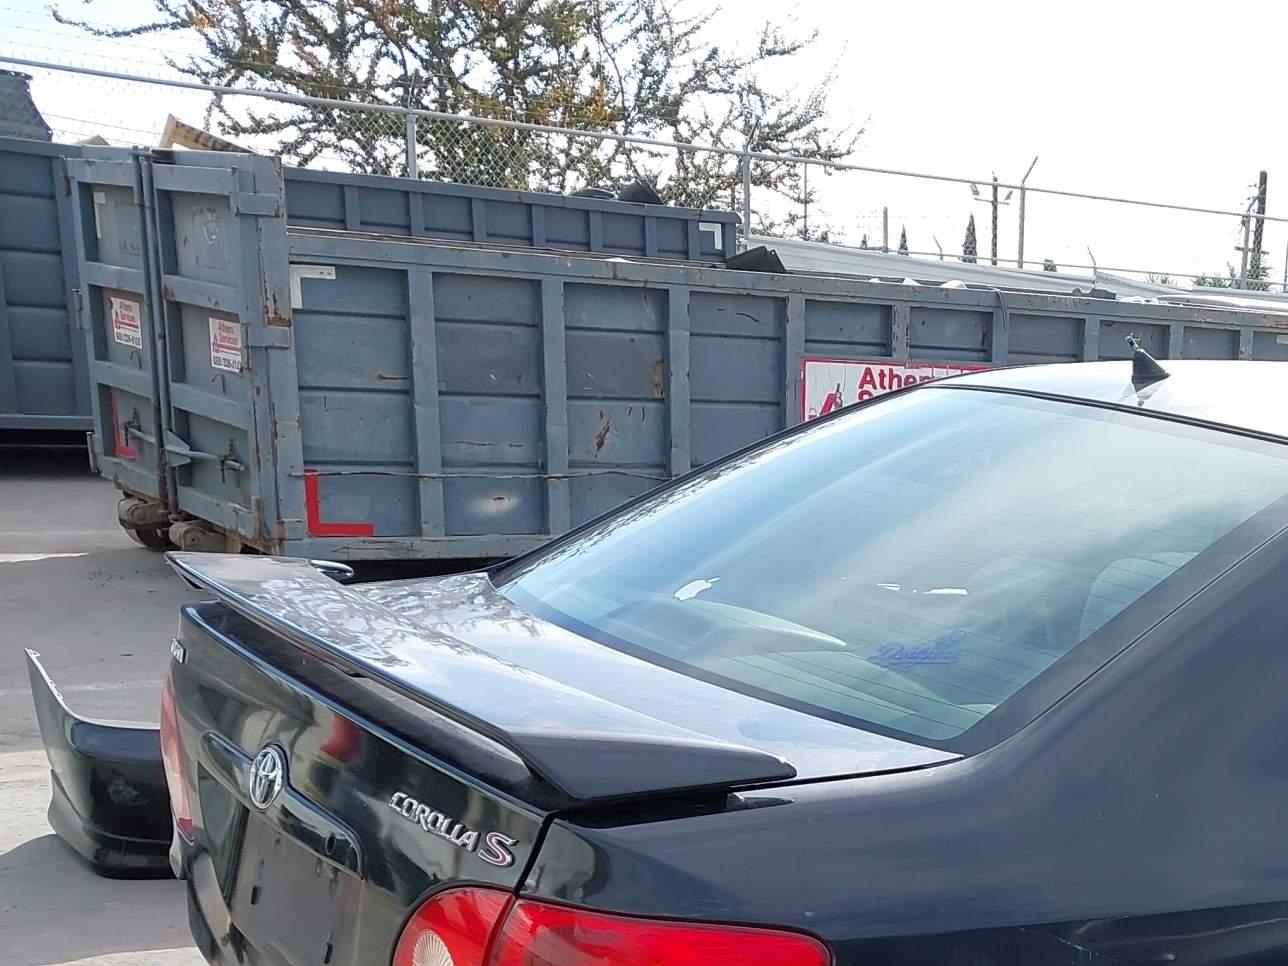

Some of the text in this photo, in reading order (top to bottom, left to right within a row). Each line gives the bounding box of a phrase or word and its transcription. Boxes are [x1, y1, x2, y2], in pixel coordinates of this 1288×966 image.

[858, 366, 935, 390] Athe
[389, 791, 519, 866] COROLLA S
